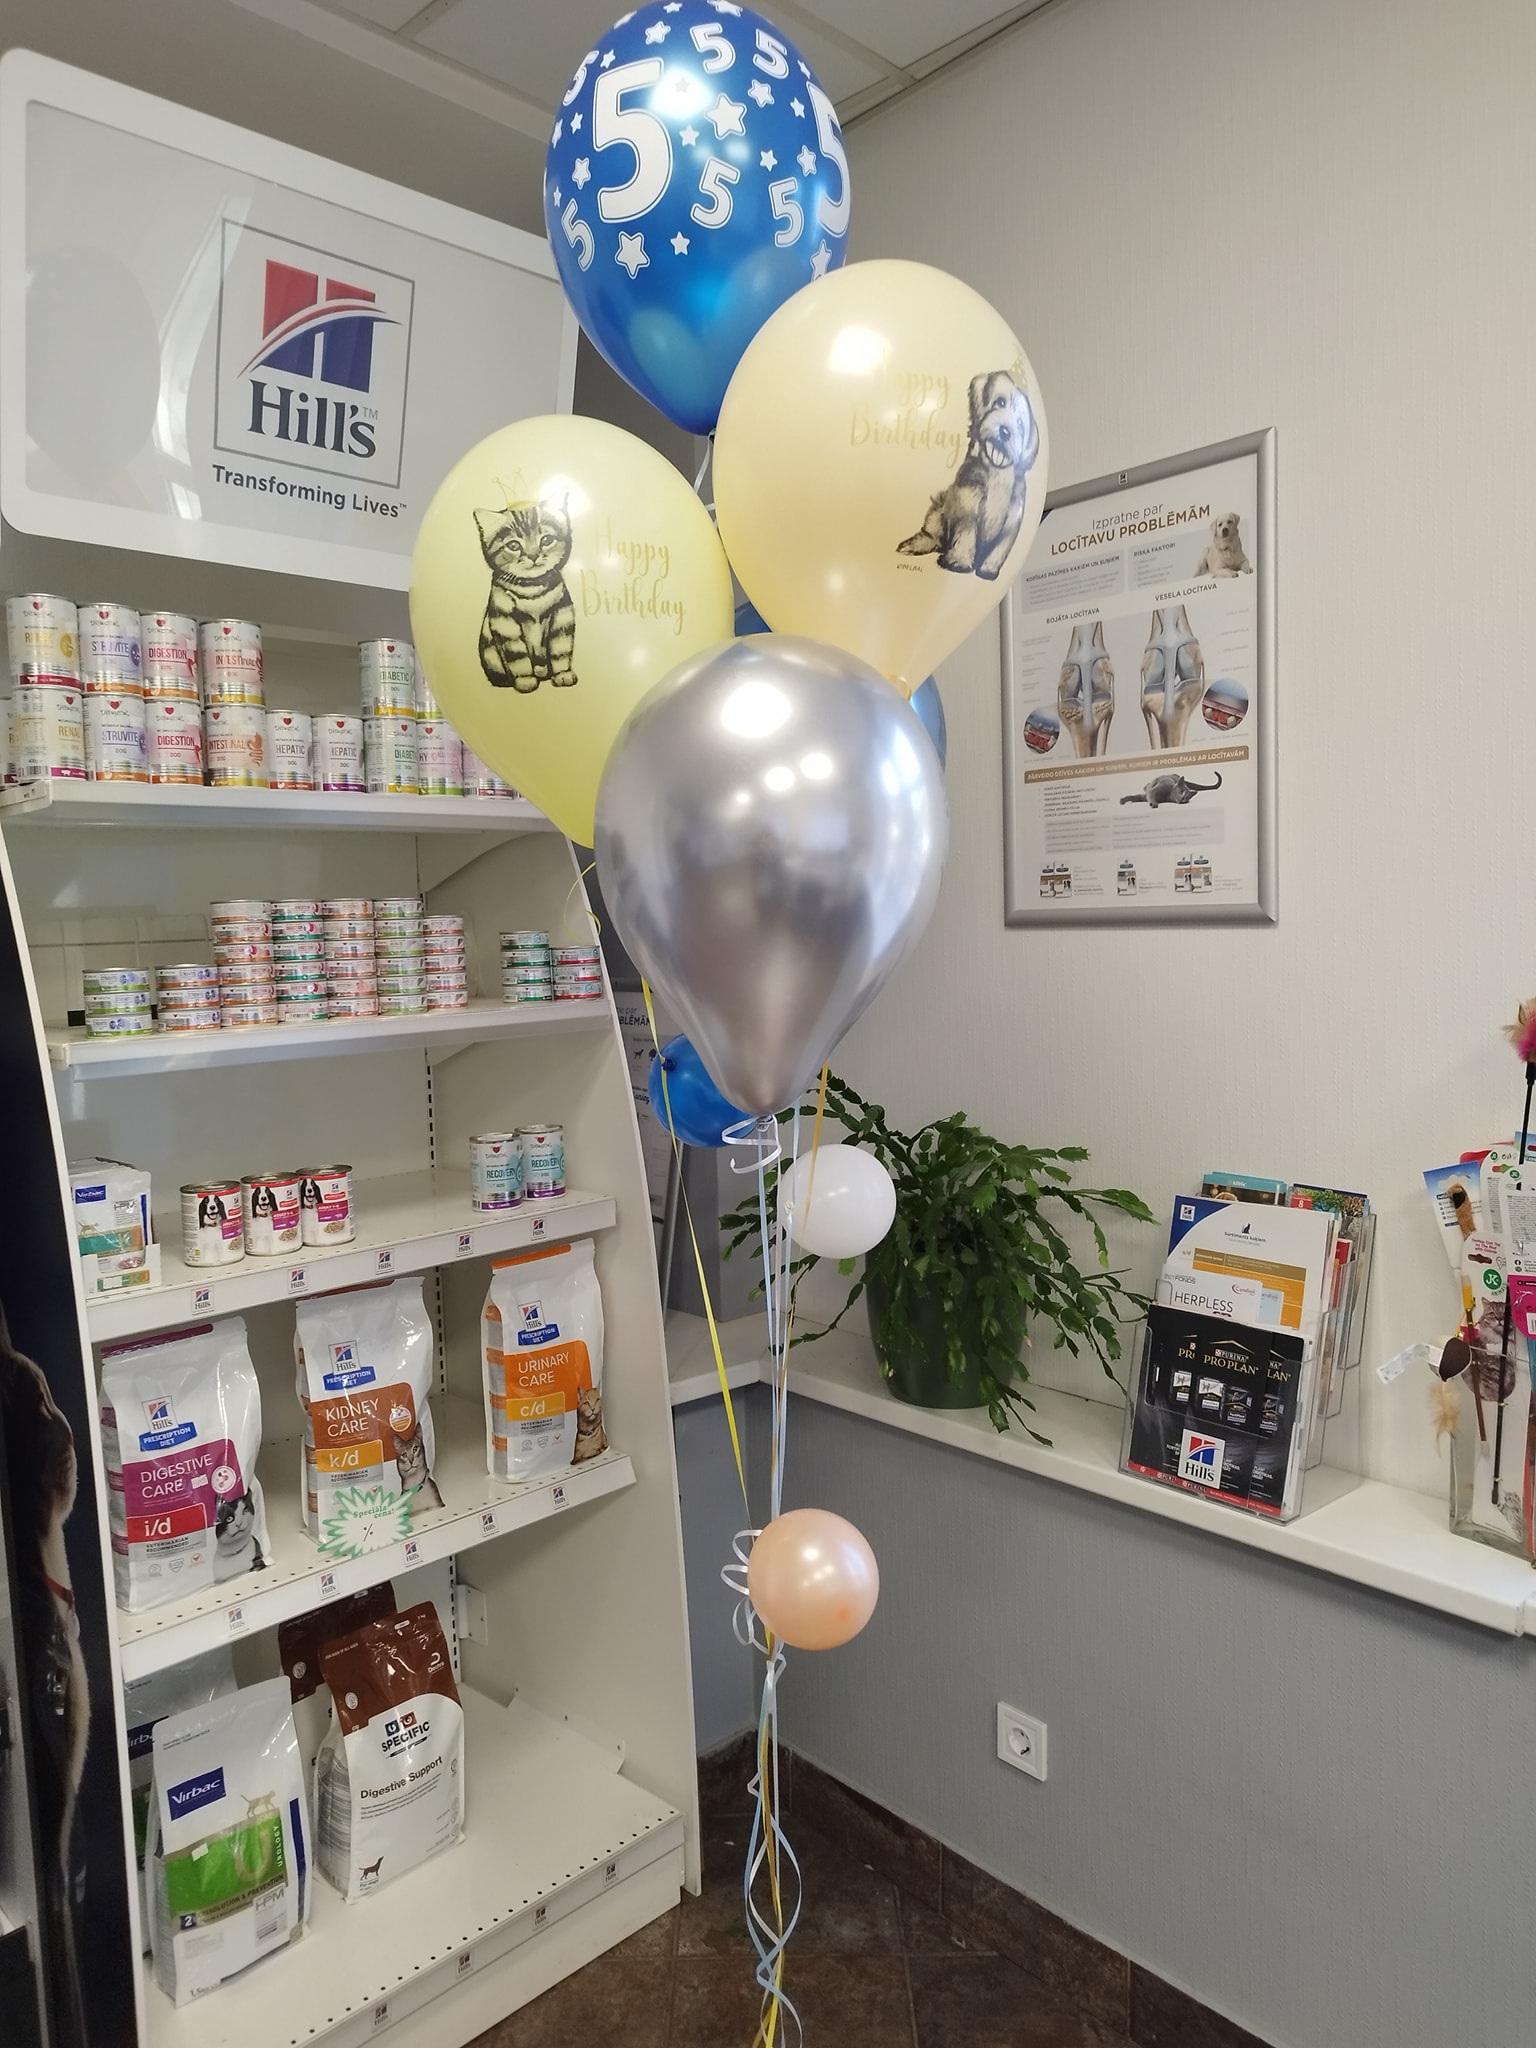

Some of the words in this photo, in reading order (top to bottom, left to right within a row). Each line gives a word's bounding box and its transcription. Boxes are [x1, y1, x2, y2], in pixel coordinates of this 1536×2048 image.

[689, 22, 736, 73] 5
[753, 28, 789, 79] 5
[562, 50, 600, 106] 5
[593, 57, 673, 223] 5
[806, 80, 851, 238] 5
[690, 156, 741, 229] 5
[768, 177, 804, 248] 5
[561, 198, 595, 272] 5
[850, 401, 961, 469] Birthday
[212, 464, 346, 510] Transforming
[1092, 509, 1140, 531] Izpratne
[1143, 503, 1164, 521] par
[1051, 530, 1115, 556] LOCĪTAVU
[1119, 504, 1211, 539] PROBLĒMĀM
[593, 515, 670, 579] Happy
[580, 568, 684, 636] Birthday
[1154, 589, 1181, 602] VESELA
[1183, 583, 1218, 597] LOCĪTAVA
[1046, 614, 1069, 625] BOJĀTA
[1070, 608, 1100, 620] LOCĪTAVA
[148, 648, 187, 659] DIGESTION
[102, 730, 139, 743] STRUVITE
[157, 735, 195, 746] DIGESTION
[276, 744, 306, 755] HEPATIC
[329, 747, 357, 758] HEPATIC
[394, 749, 417, 760] DIABET
[619, 1014, 650, 1026] BLĒMĀ
[530, 1157, 558, 1168] RECOVER
[486, 1167, 515, 1179] RECOVER
[1298, 1200, 1304, 1208] 8
[1485, 1273, 1499, 1286] JK
[1175, 1291, 1233, 1312] HERPLESS
[336, 1361, 357, 1372] Hill's
[518, 1352, 569, 1374] URINARY
[1204, 1354, 1226, 1370] PRO
[519, 1371, 555, 1387] CARE
[326, 1398, 379, 1422] KIDNEY
[520, 1401, 545, 1416] c/d
[152, 1418, 173, 1431] Hill's
[327, 1417, 369, 1437] CARE
[143, 1426, 191, 1444] PRESCRIPTION
[160, 1438, 175, 1447] DIET
[140, 1454, 213, 1483] DIGESTIVE
[329, 1450, 359, 1468] k/d
[1185, 1462, 1215, 1482] Hill's
[142, 1478, 184, 1499] CARE
[145, 1517, 171, 1537] i/d
[381, 1720, 430, 1753] SPECIFIC
[360, 1778, 406, 1800] Digestive
[408, 1756, 443, 1783] Support
[172, 1779, 221, 1804] Virbac
[255, 1887, 285, 1911] HPM
[185, 1916, 193, 1926] 2
